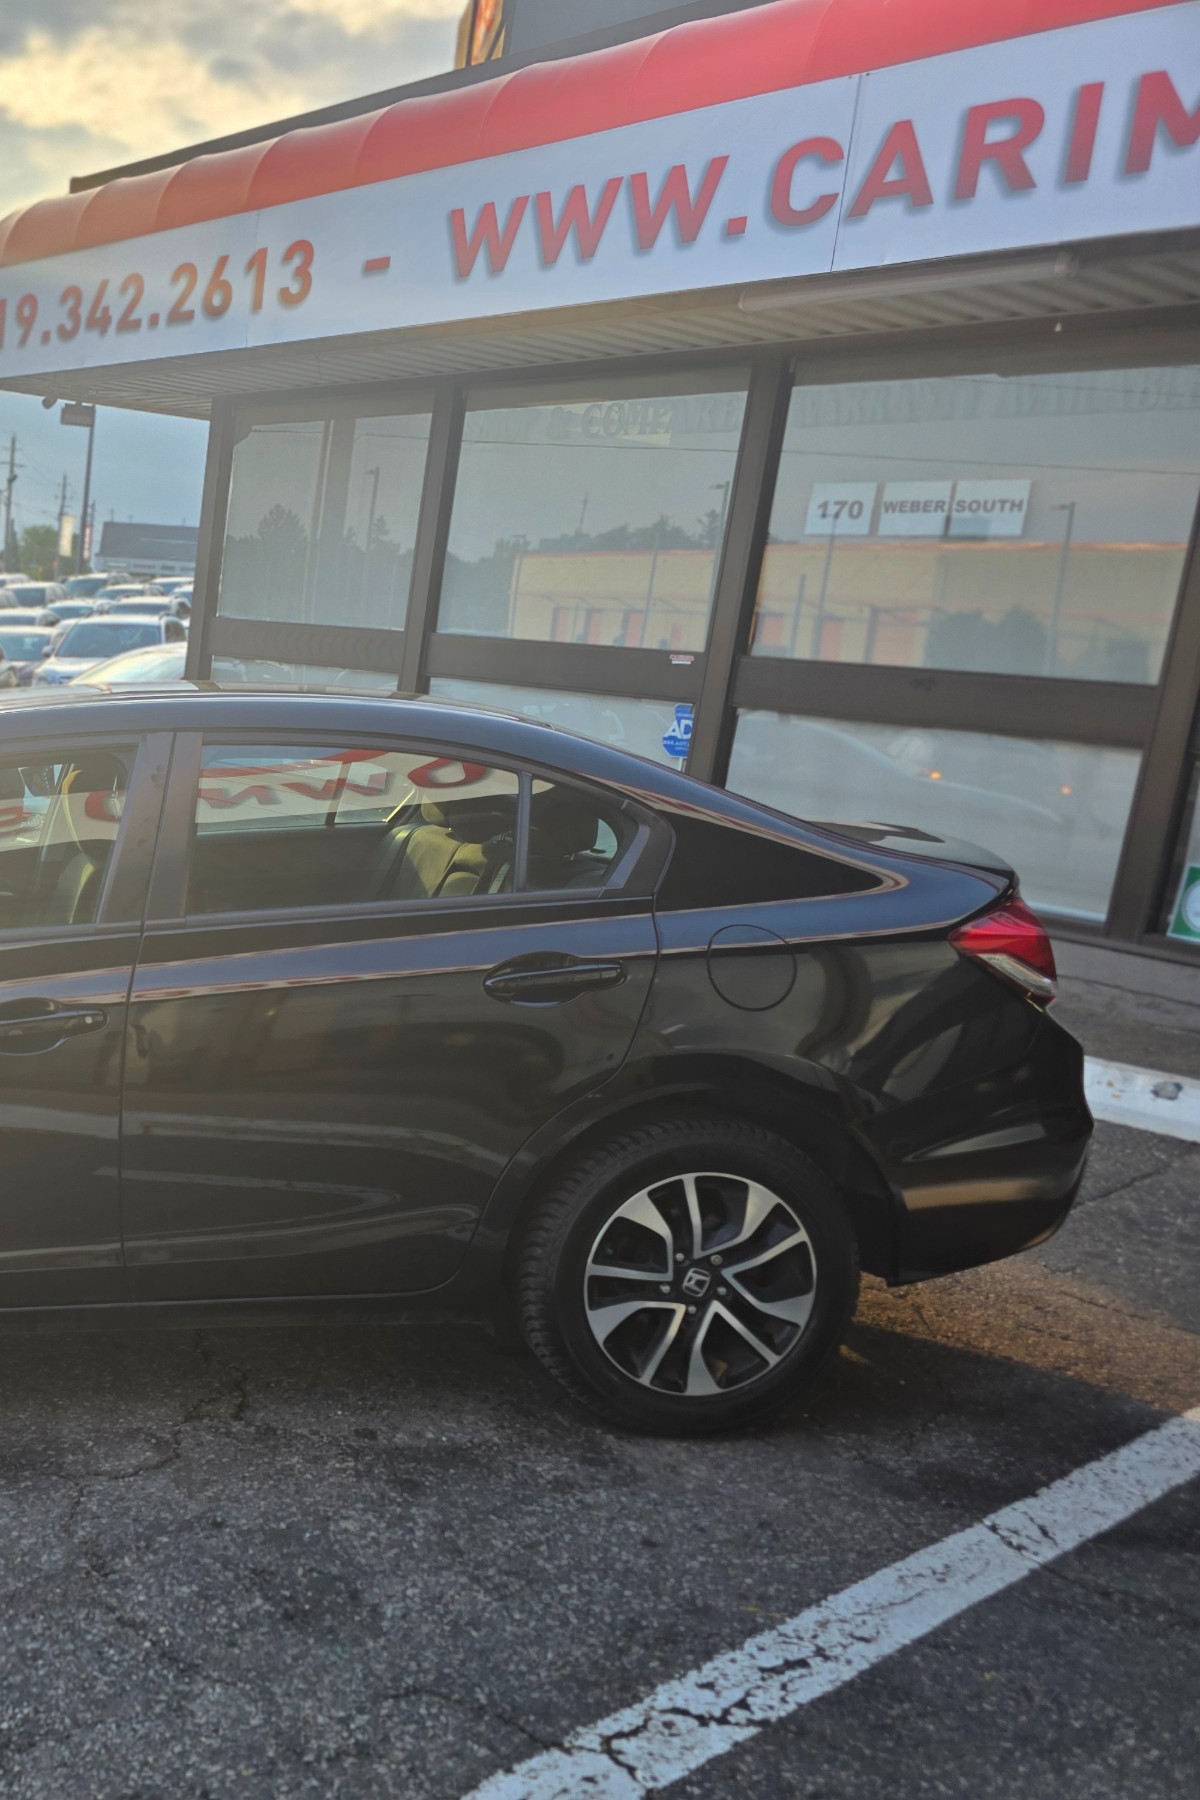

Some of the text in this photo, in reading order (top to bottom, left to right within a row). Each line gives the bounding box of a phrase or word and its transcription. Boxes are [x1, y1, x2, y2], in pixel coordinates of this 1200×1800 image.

[450, 70, 1200, 279] WWW.CARIM
[817, 499, 1024, 520] 170 WEBER SOUTH
